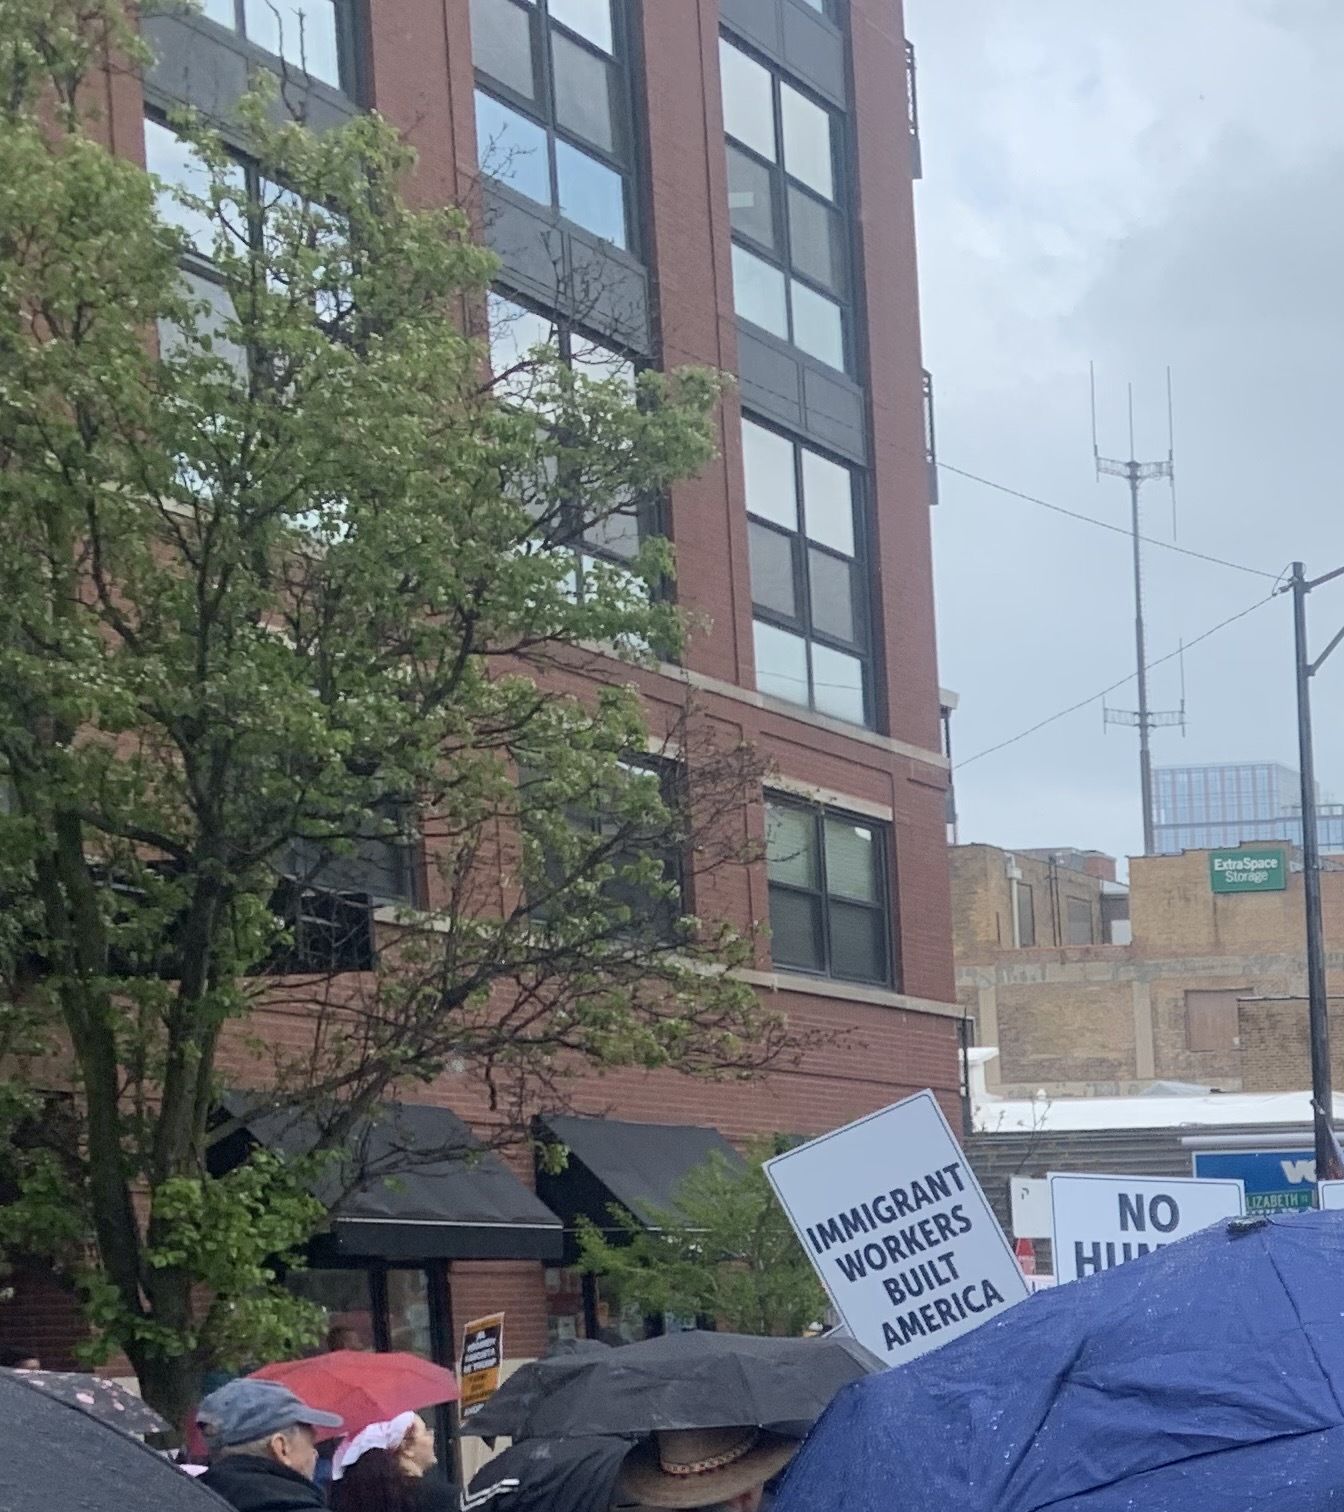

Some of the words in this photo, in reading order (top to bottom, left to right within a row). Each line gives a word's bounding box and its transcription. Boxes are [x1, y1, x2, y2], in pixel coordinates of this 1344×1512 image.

[1225, 870, 1268, 883] Storage
[806, 1162, 967, 1254] IMMIGRANT
[1118, 1193, 1180, 1233] NO
[1246, 1193, 1298, 1208] LIZABETH
[835, 1204, 973, 1283] WORKERS
[883, 1252, 960, 1306] BUILT
[882, 1279, 1004, 1352] AMERICA
